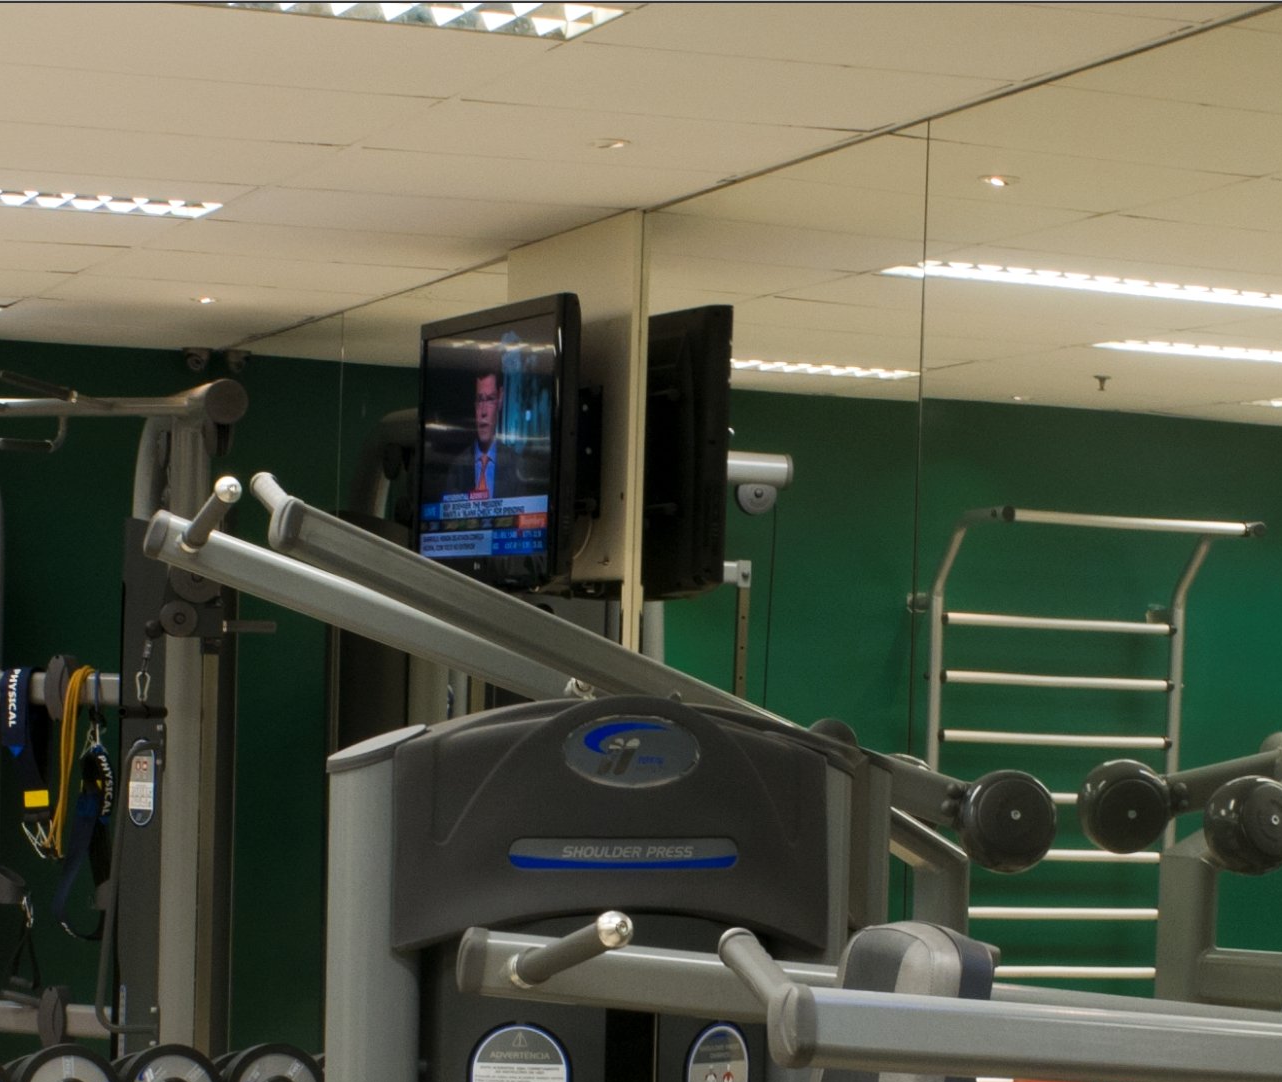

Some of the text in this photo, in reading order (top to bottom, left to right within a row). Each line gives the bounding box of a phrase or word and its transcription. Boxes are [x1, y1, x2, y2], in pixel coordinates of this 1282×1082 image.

[7, 668, 22, 728] PHYSICAL
[97, 754, 114, 816] PHYSICAL
[561, 845, 694, 859] SHOULDER PRESS
